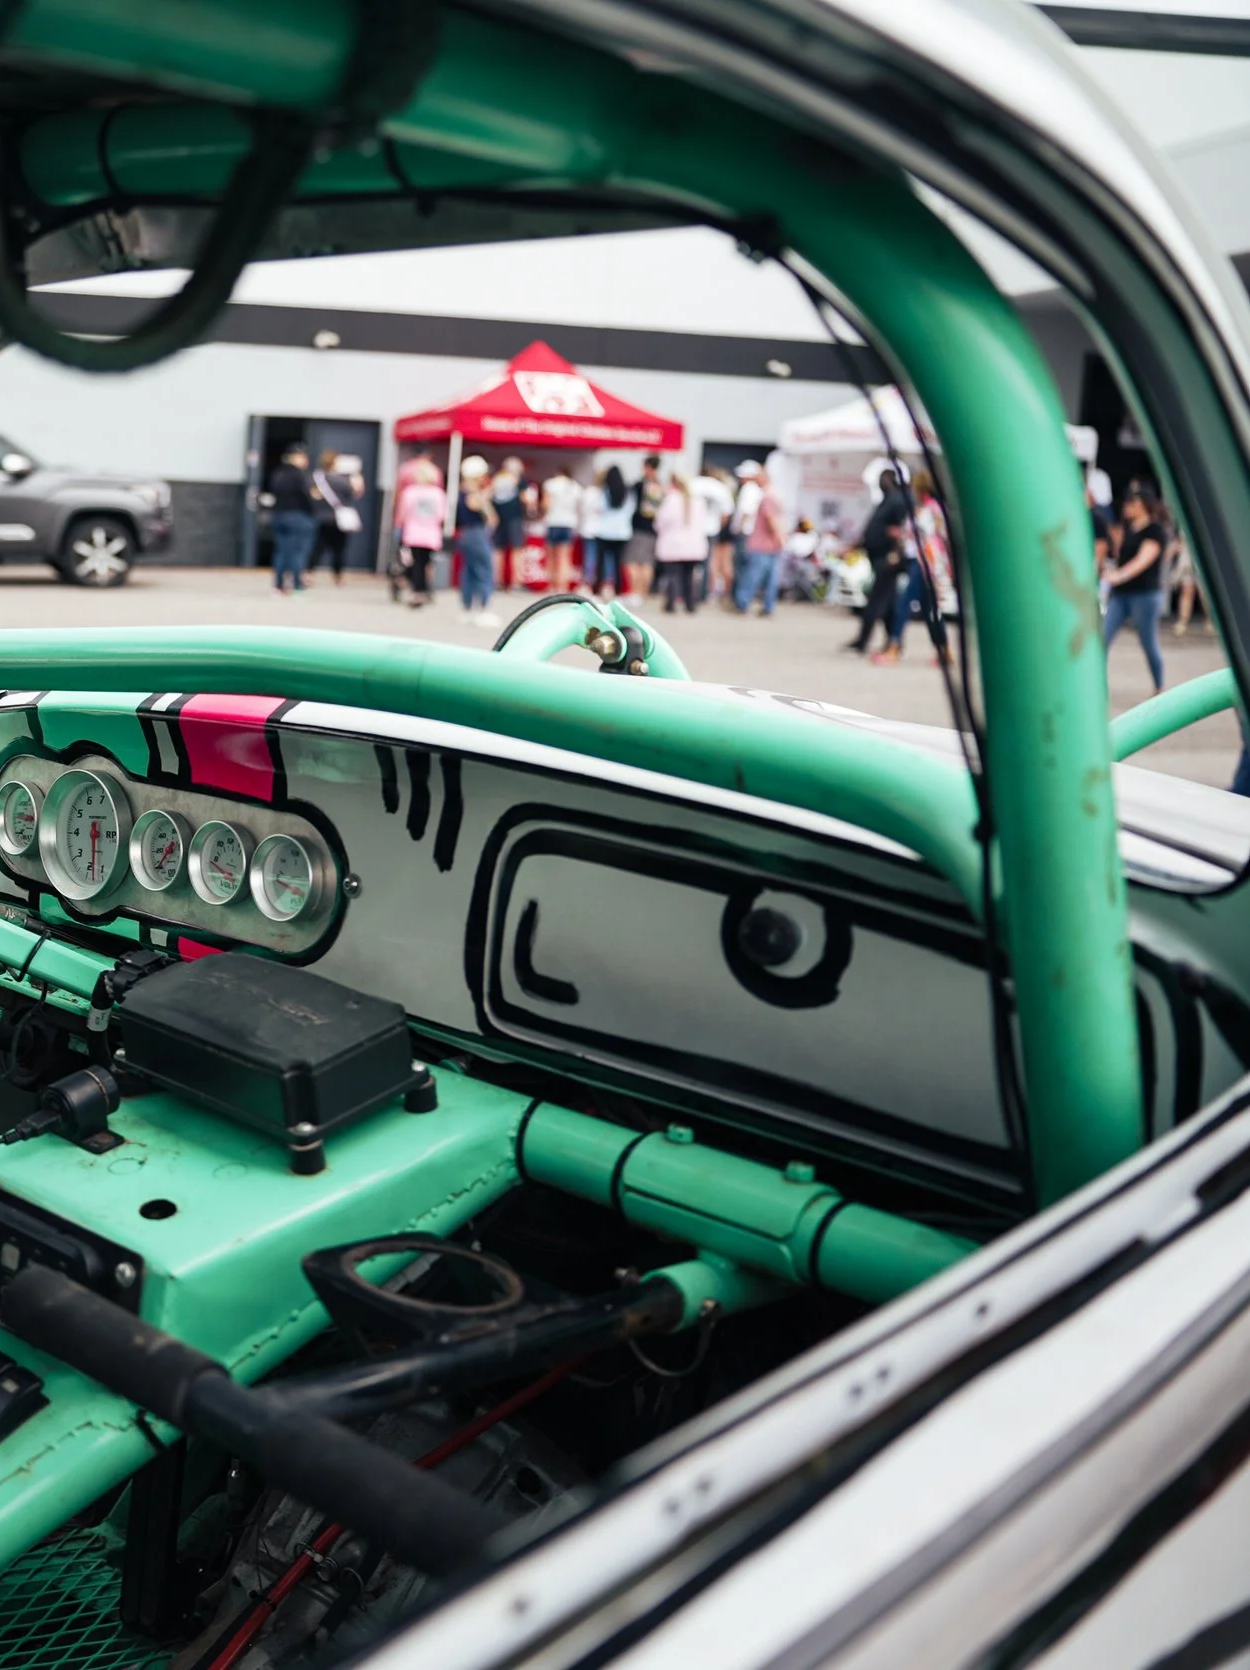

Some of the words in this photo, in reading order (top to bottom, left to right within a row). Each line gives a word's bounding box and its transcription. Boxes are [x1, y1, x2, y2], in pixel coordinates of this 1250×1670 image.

[86, 796, 93, 806] 6
[99, 795, 106, 805] 7
[76, 809, 84, 819] 5
[73, 827, 80, 837] 4
[77, 848, 83, 858] 3
[213, 855, 220, 863] 8
[86, 861, 94, 871] 2
[100, 864, 105, 874] 1
